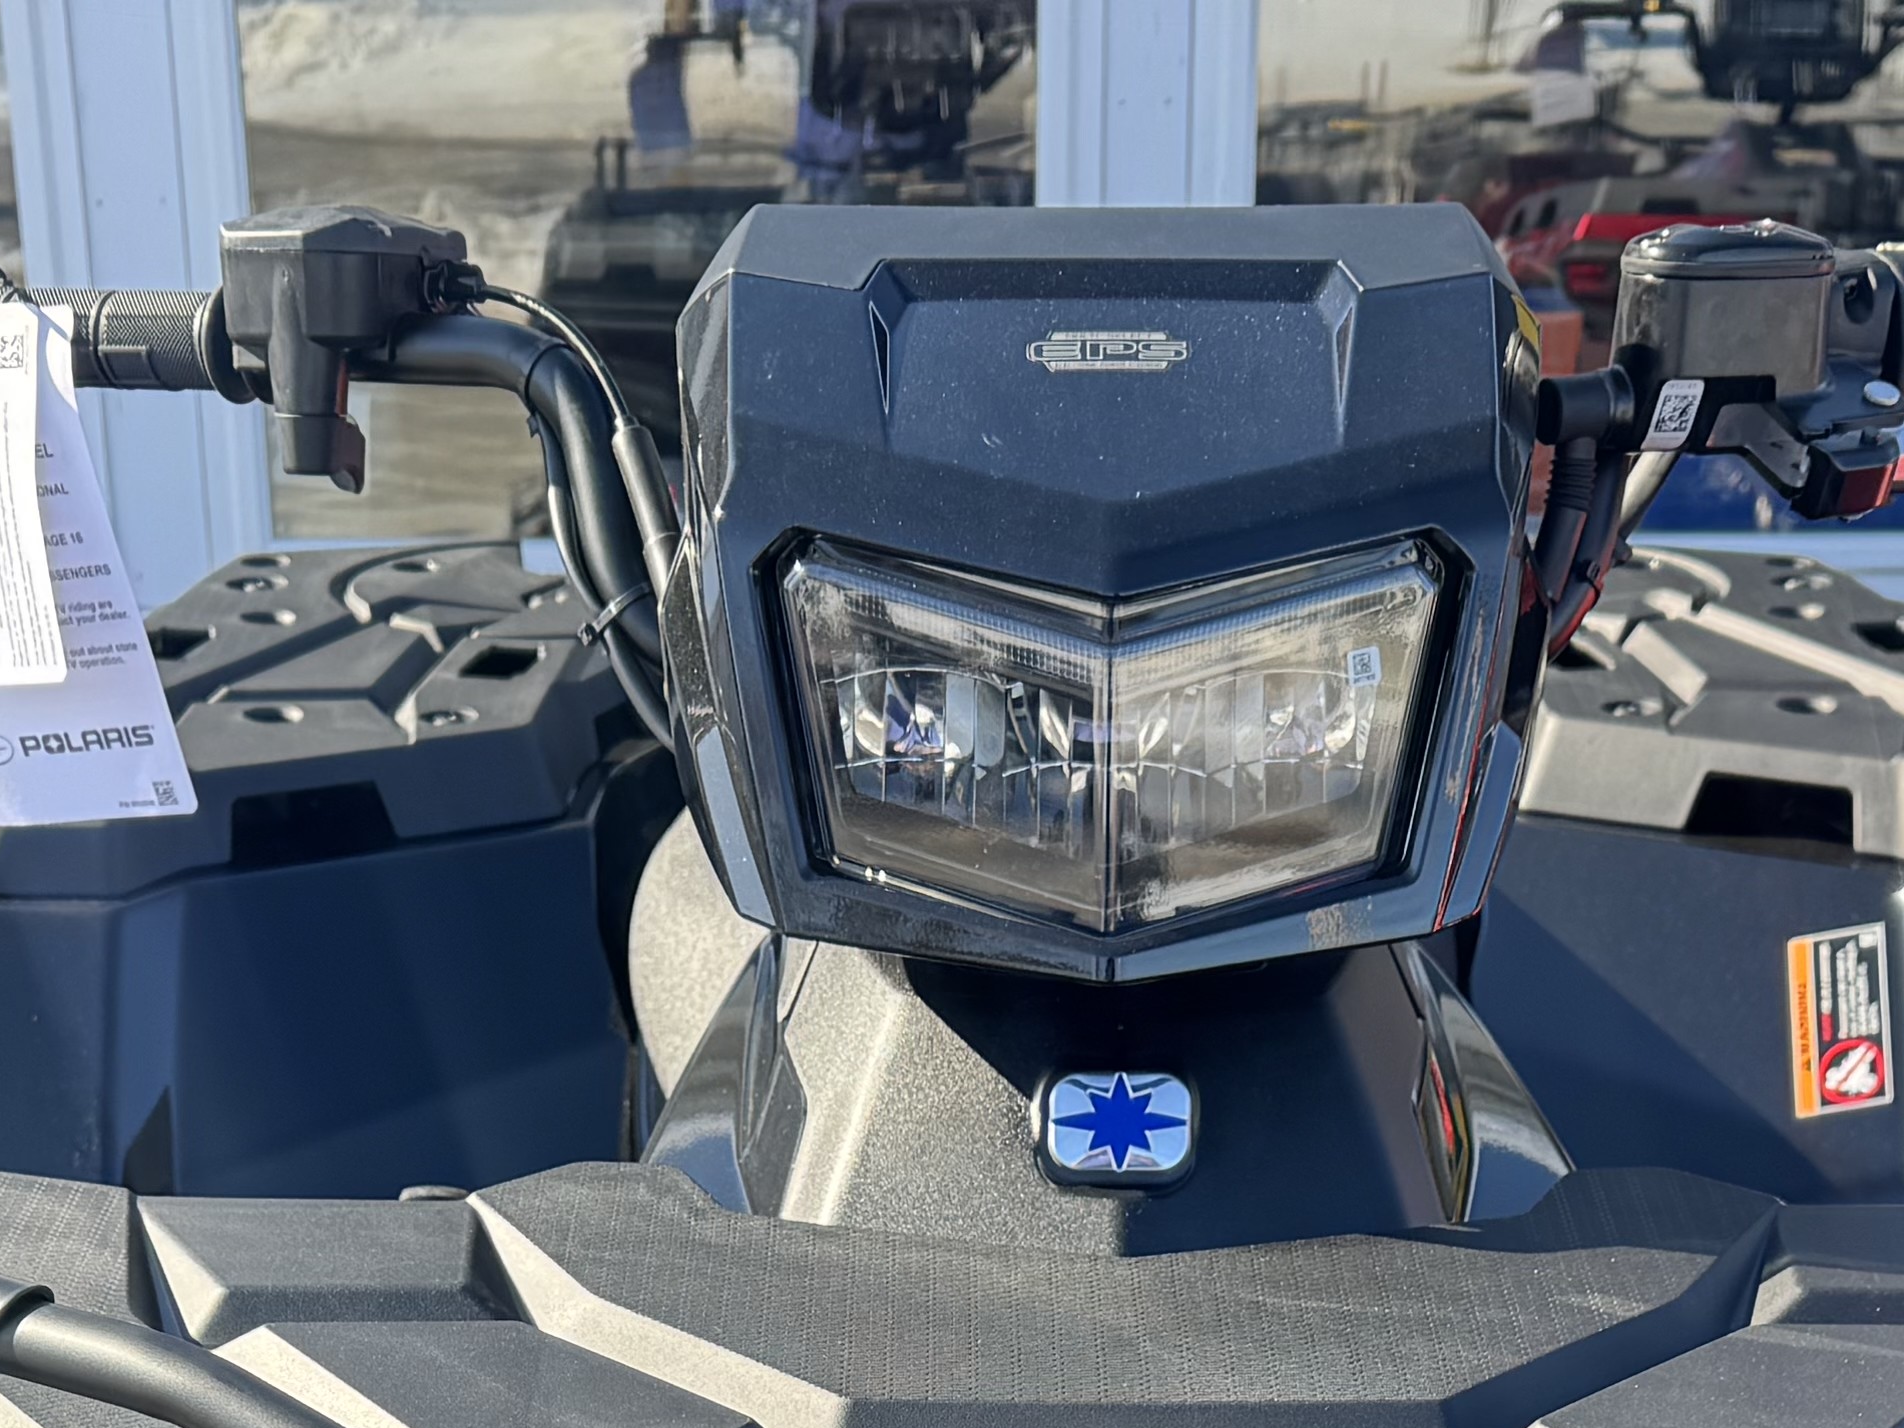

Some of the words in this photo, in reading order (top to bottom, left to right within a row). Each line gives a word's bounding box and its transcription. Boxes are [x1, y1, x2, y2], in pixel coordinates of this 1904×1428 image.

[1025, 340, 1187, 361] EPS
[50, 563, 112, 582] SENGERS
[18, 725, 154, 757] POLARIS
